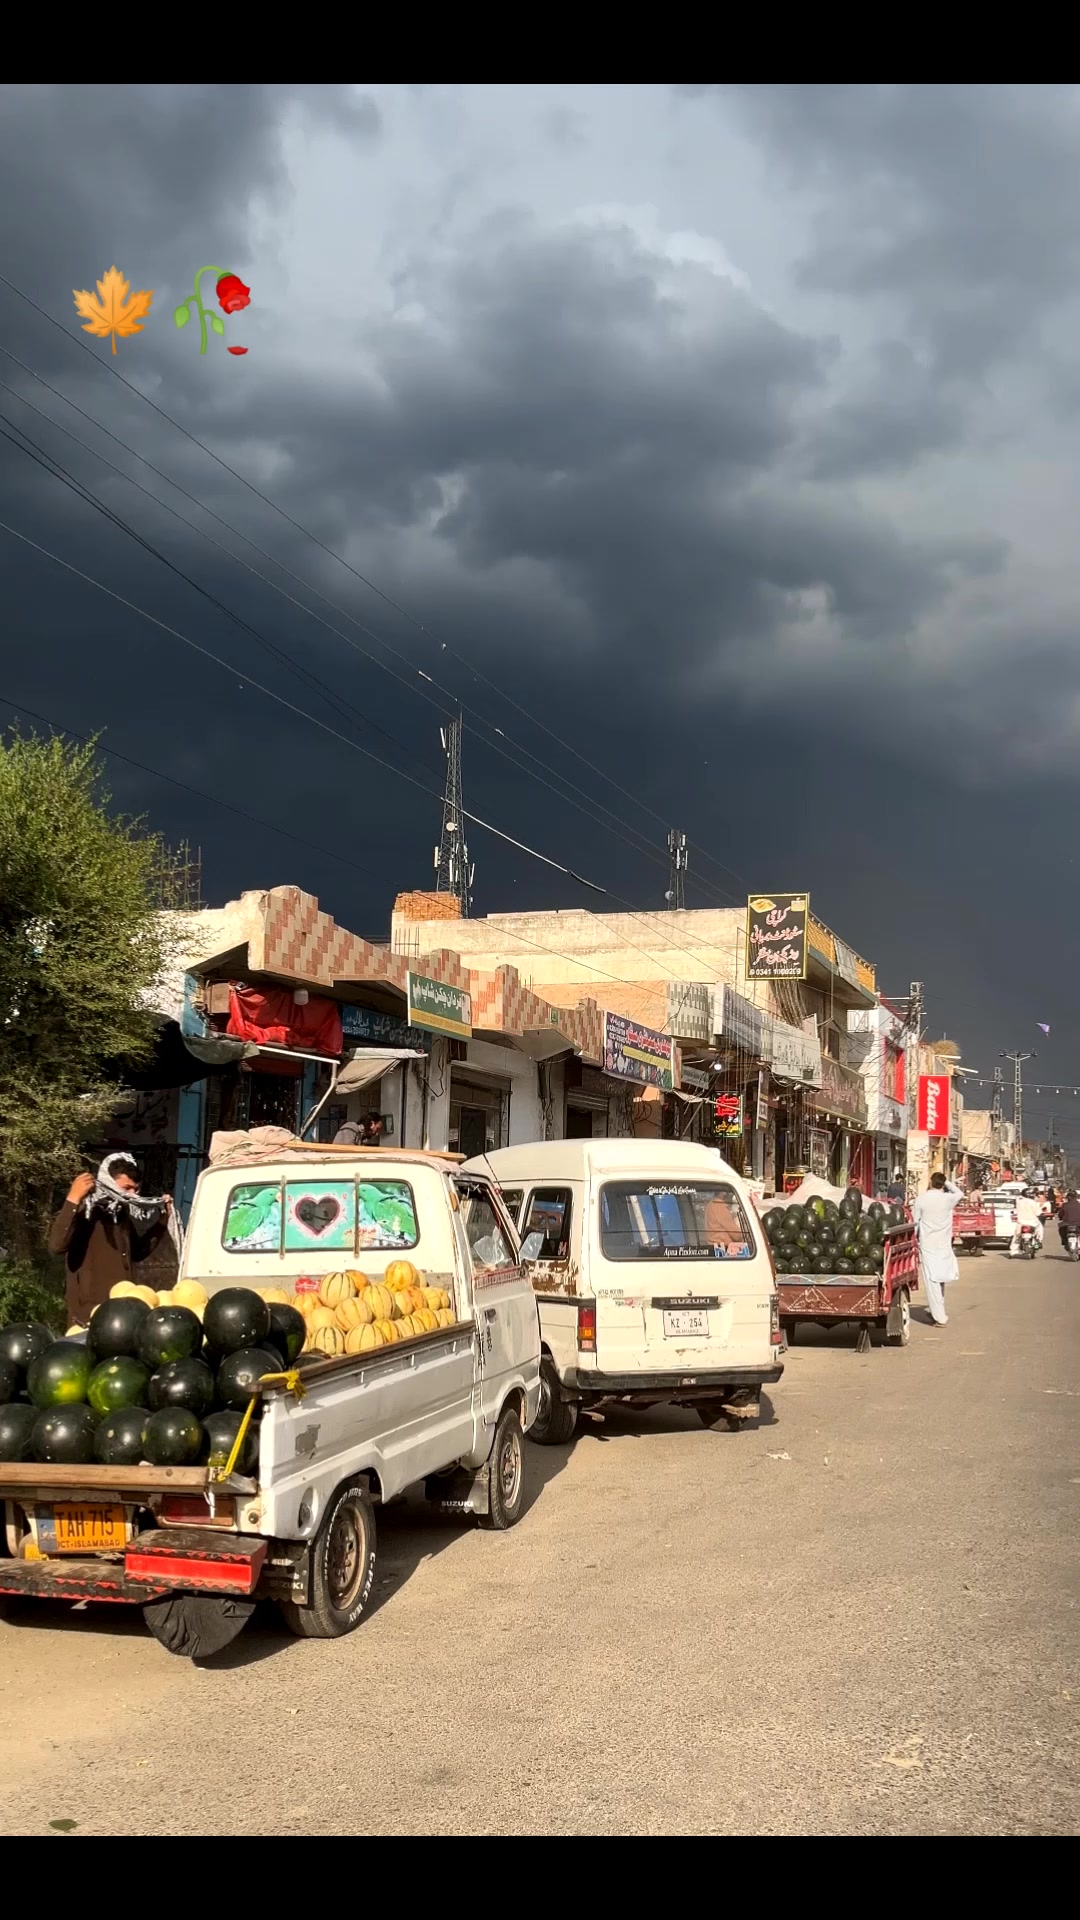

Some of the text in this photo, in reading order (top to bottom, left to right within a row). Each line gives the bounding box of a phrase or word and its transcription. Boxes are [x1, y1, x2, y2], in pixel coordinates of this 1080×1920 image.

[925, 1079, 941, 1132] Bata
[670, 1317, 702, 1328] KZ 254
[55, 1509, 114, 1538] TAH-715
